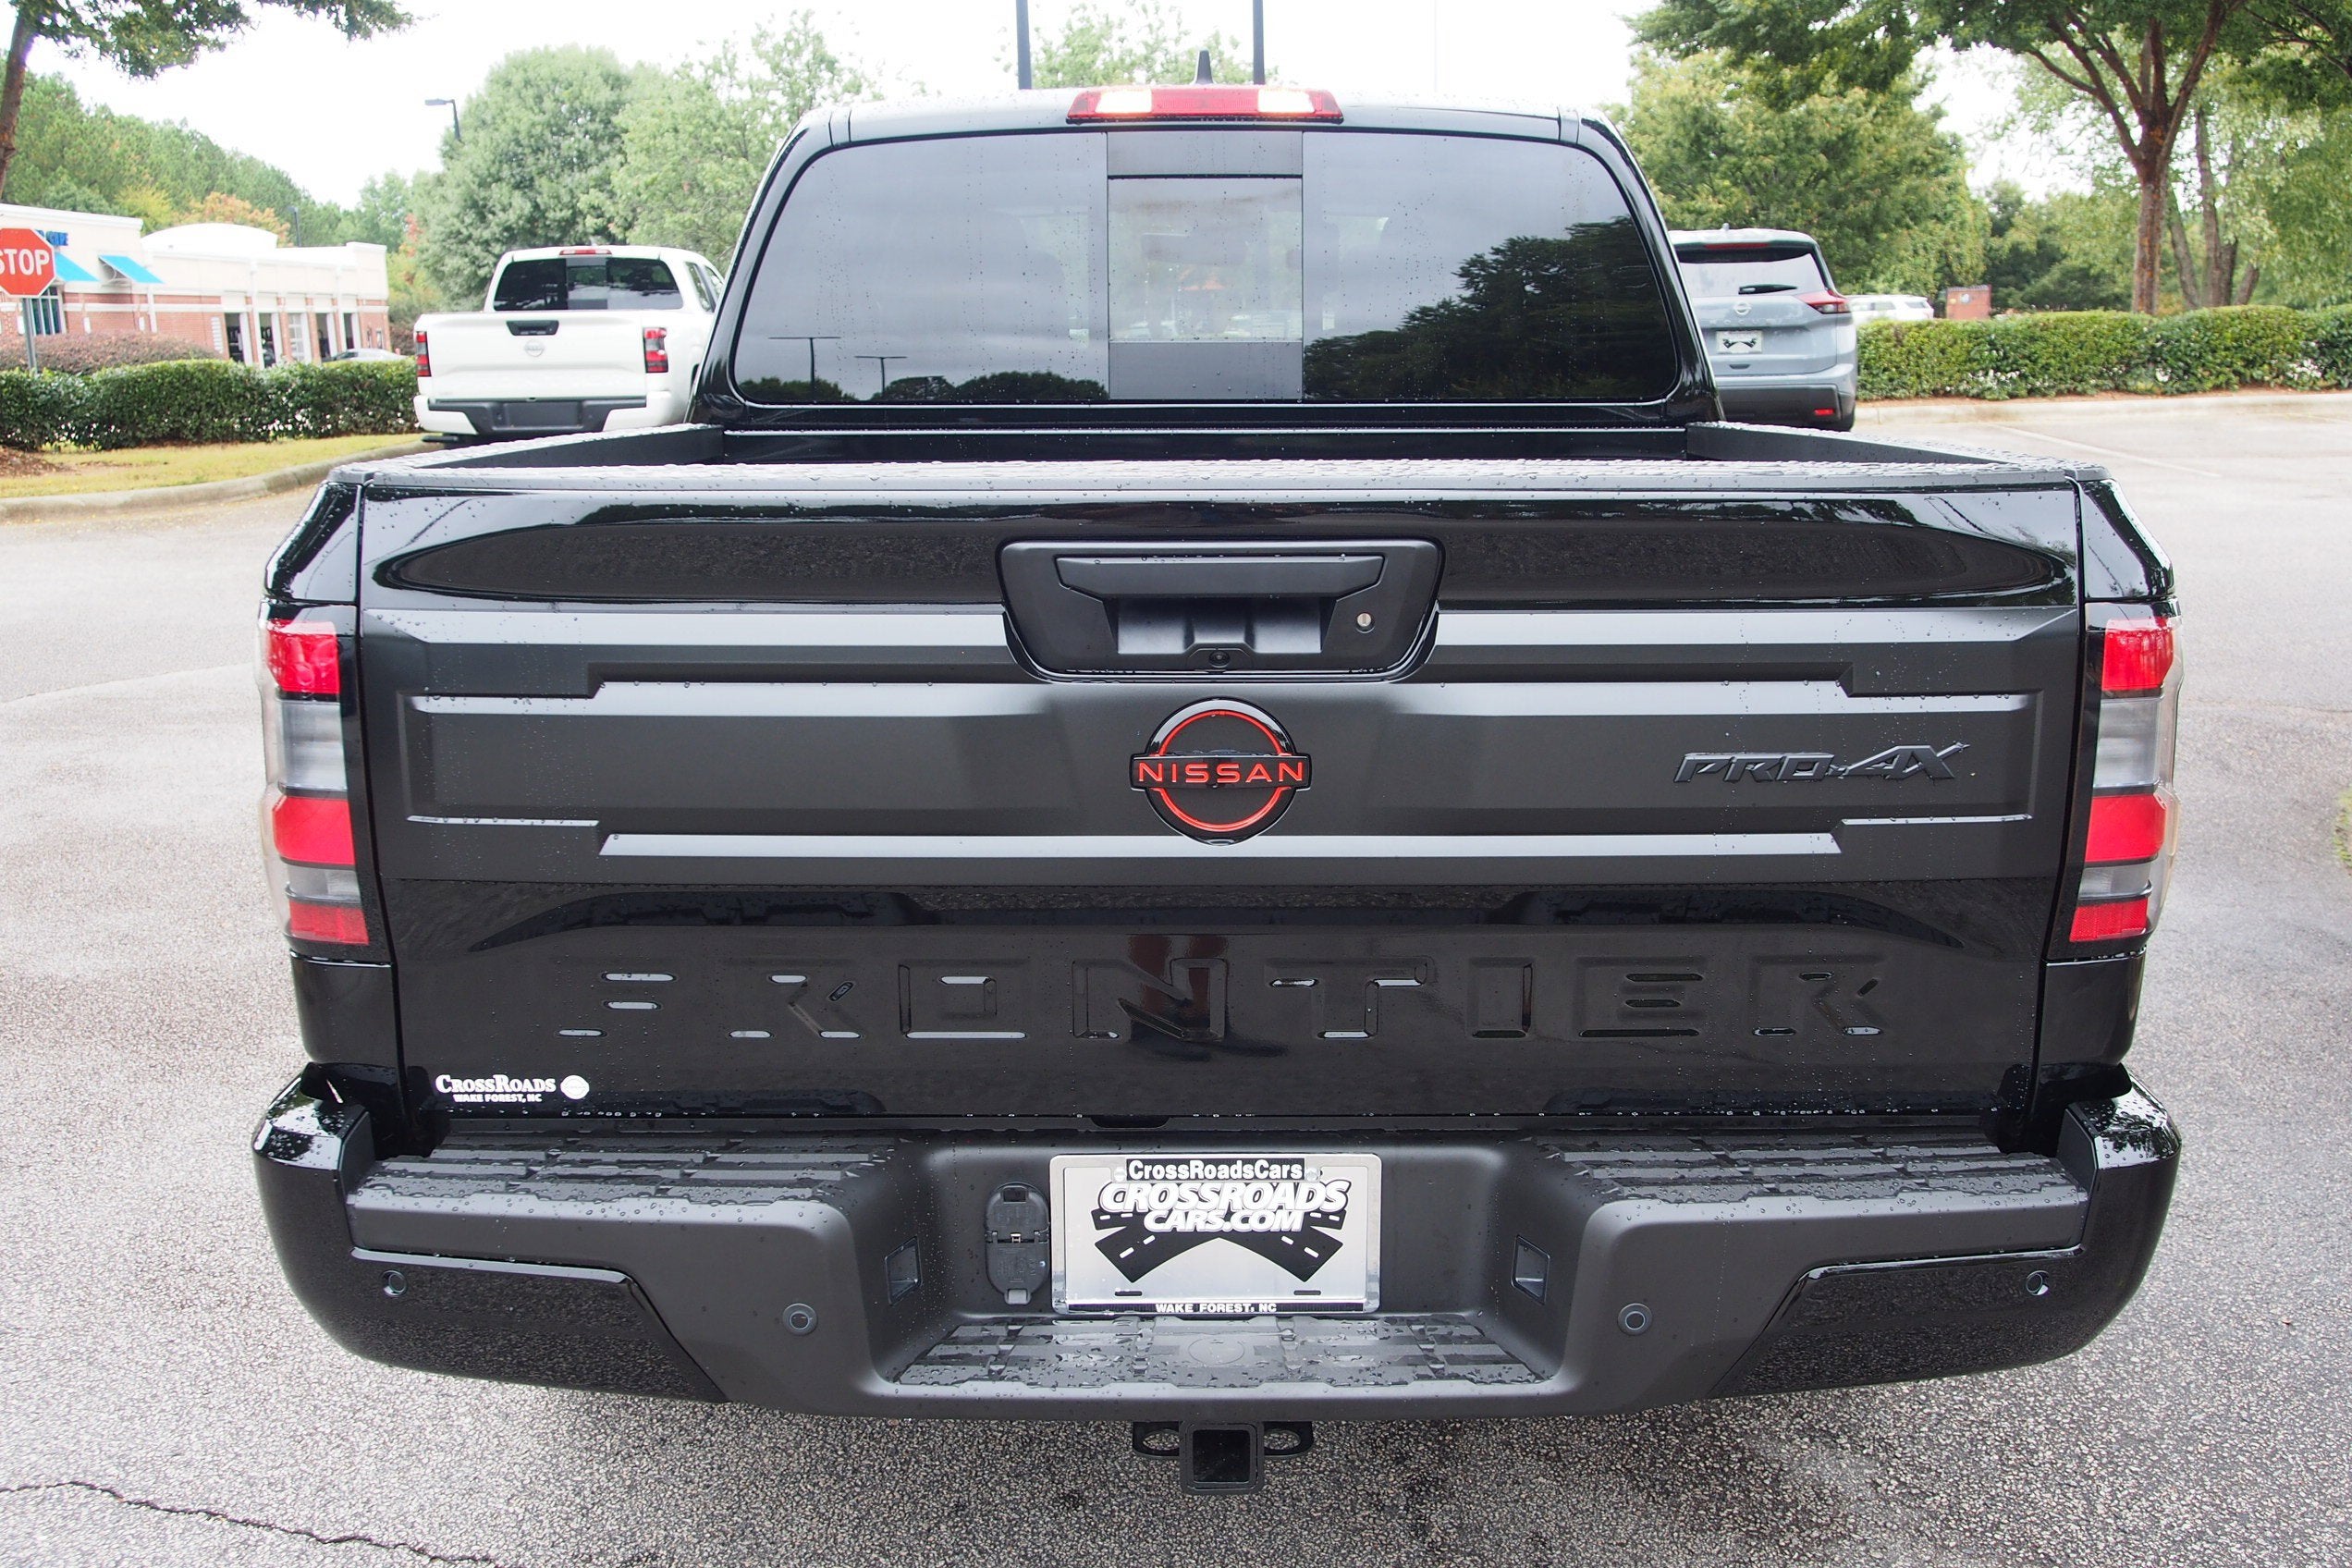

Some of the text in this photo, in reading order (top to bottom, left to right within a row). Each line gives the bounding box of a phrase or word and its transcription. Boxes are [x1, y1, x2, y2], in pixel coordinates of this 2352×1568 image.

[1138, 762, 1303, 783] NISSAN
[557, 956, 1886, 1041] FRONTIER
[453, 1094, 484, 1102] WAKE
[527, 1094, 542, 1102] NC
[1128, 1159, 1303, 1180] CrossRoadsCars
[1098, 1181, 1352, 1212] CROSSROADS
[1144, 1209, 1305, 1232] CARS.COM
[1156, 1303, 1194, 1312] WAKE
[1259, 1304, 1277, 1313] NC
